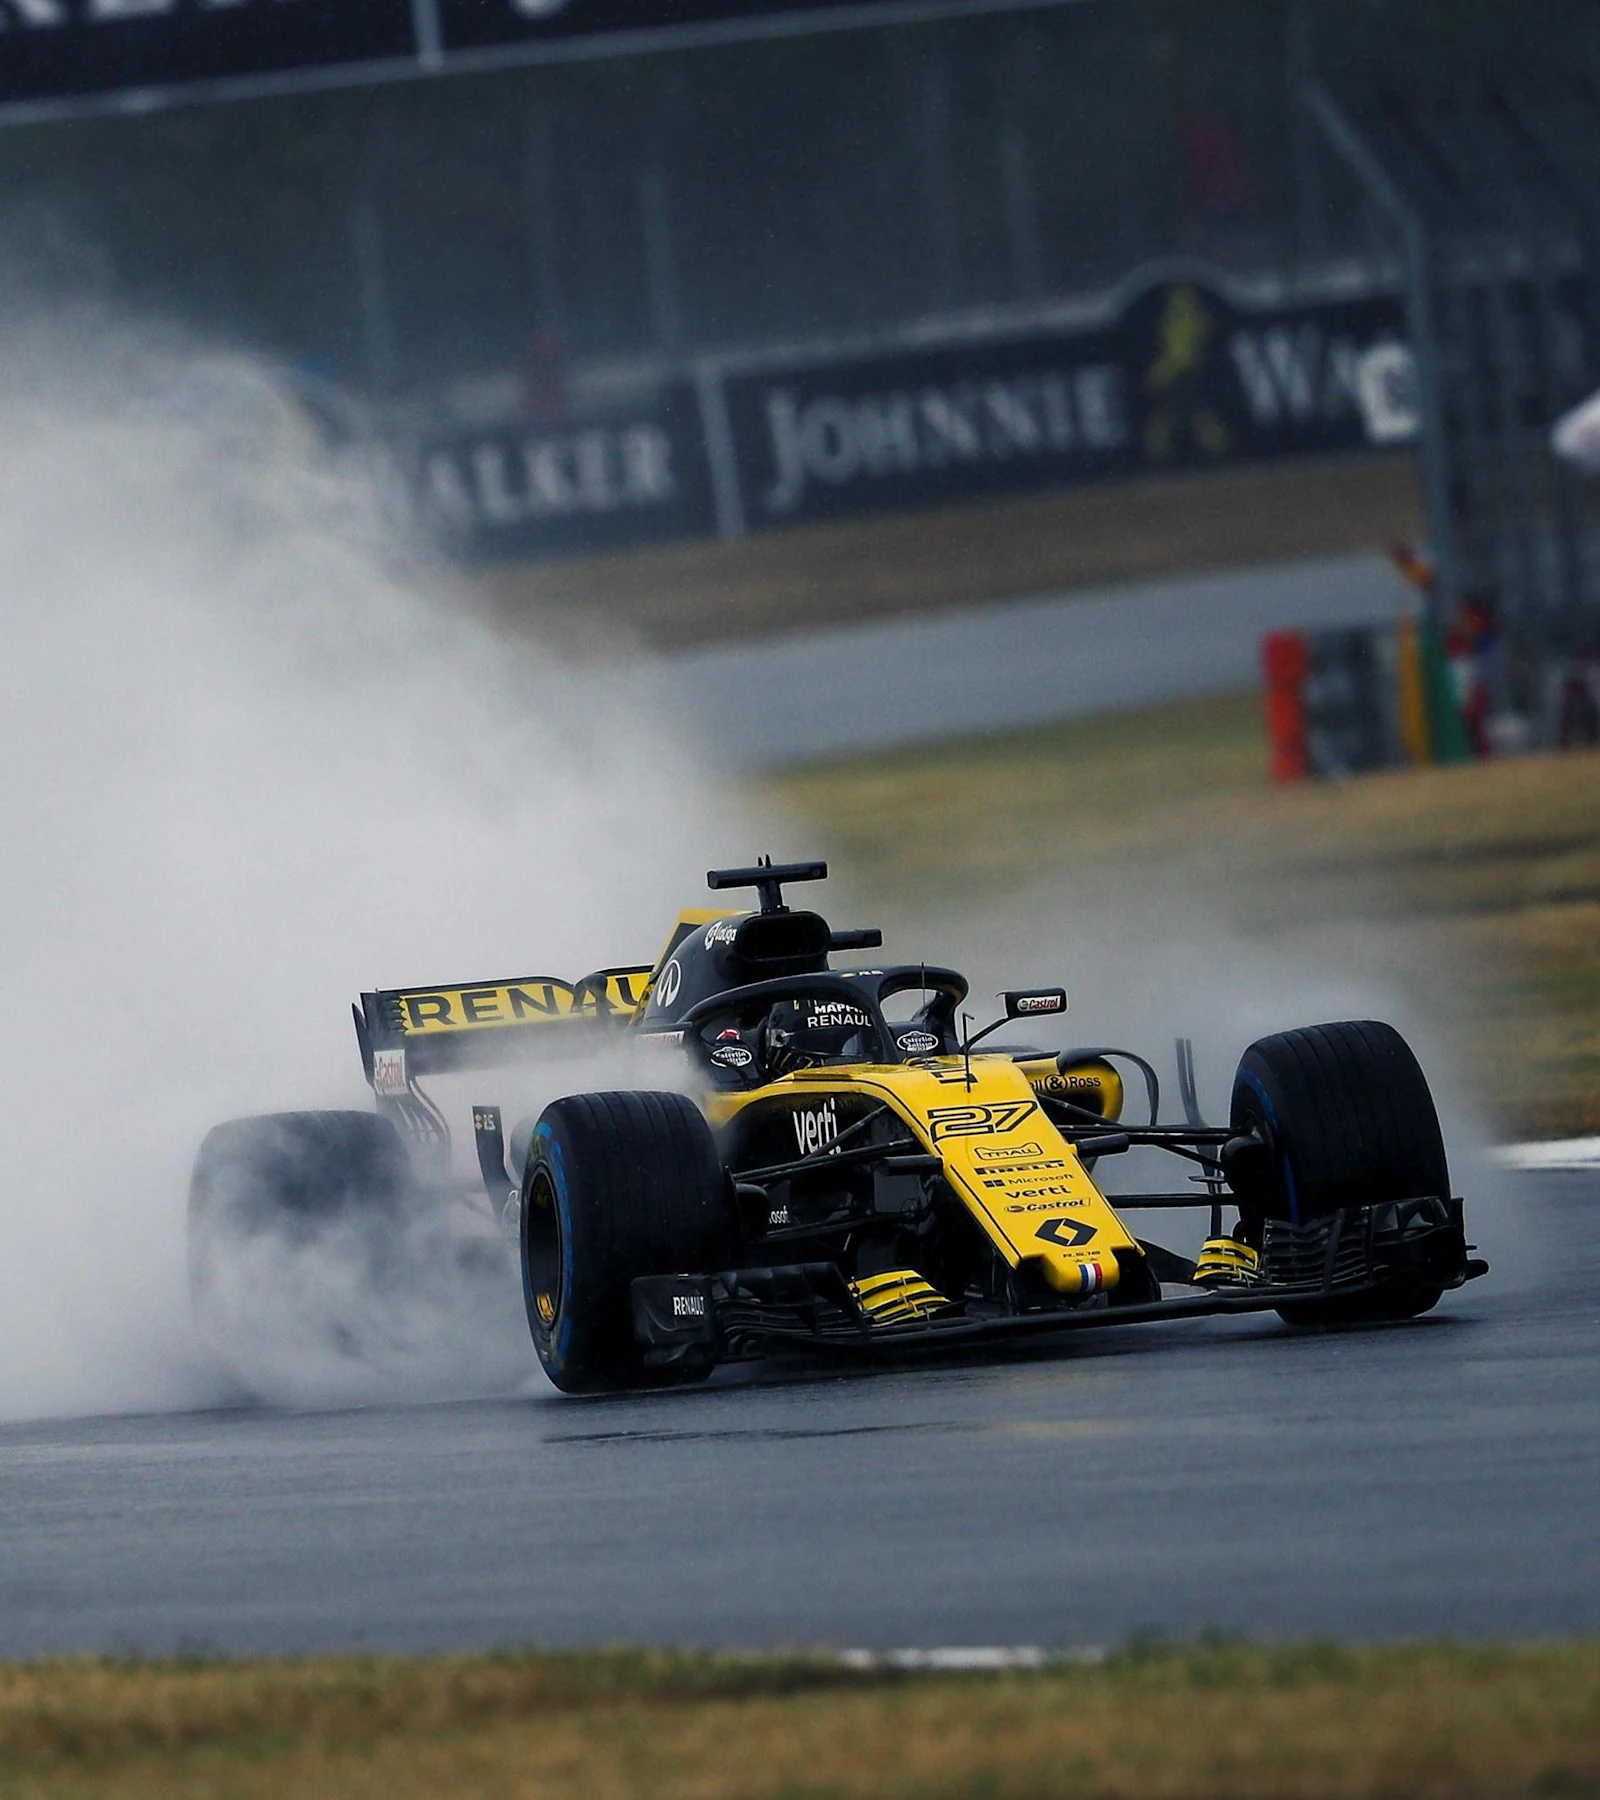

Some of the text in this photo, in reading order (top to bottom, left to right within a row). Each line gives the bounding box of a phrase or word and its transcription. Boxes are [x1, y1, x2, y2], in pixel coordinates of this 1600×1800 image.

[764, 364, 1127, 512] JOHNNIE
[405, 976, 641, 1029] RENAU
[1028, 998, 1059, 1010] Castrol
[793, 1097, 840, 1154] verti
[927, 1100, 1038, 1145] 27
[982, 1148, 1038, 1158] TMALL
[974, 1160, 1065, 1175] PIRELLI
[1008, 1173, 1075, 1185] Microsoft
[1005, 1185, 1071, 1198] verti
[1027, 1199, 1085, 1211] Castrol
[673, 1296, 704, 1316] RENAULT
